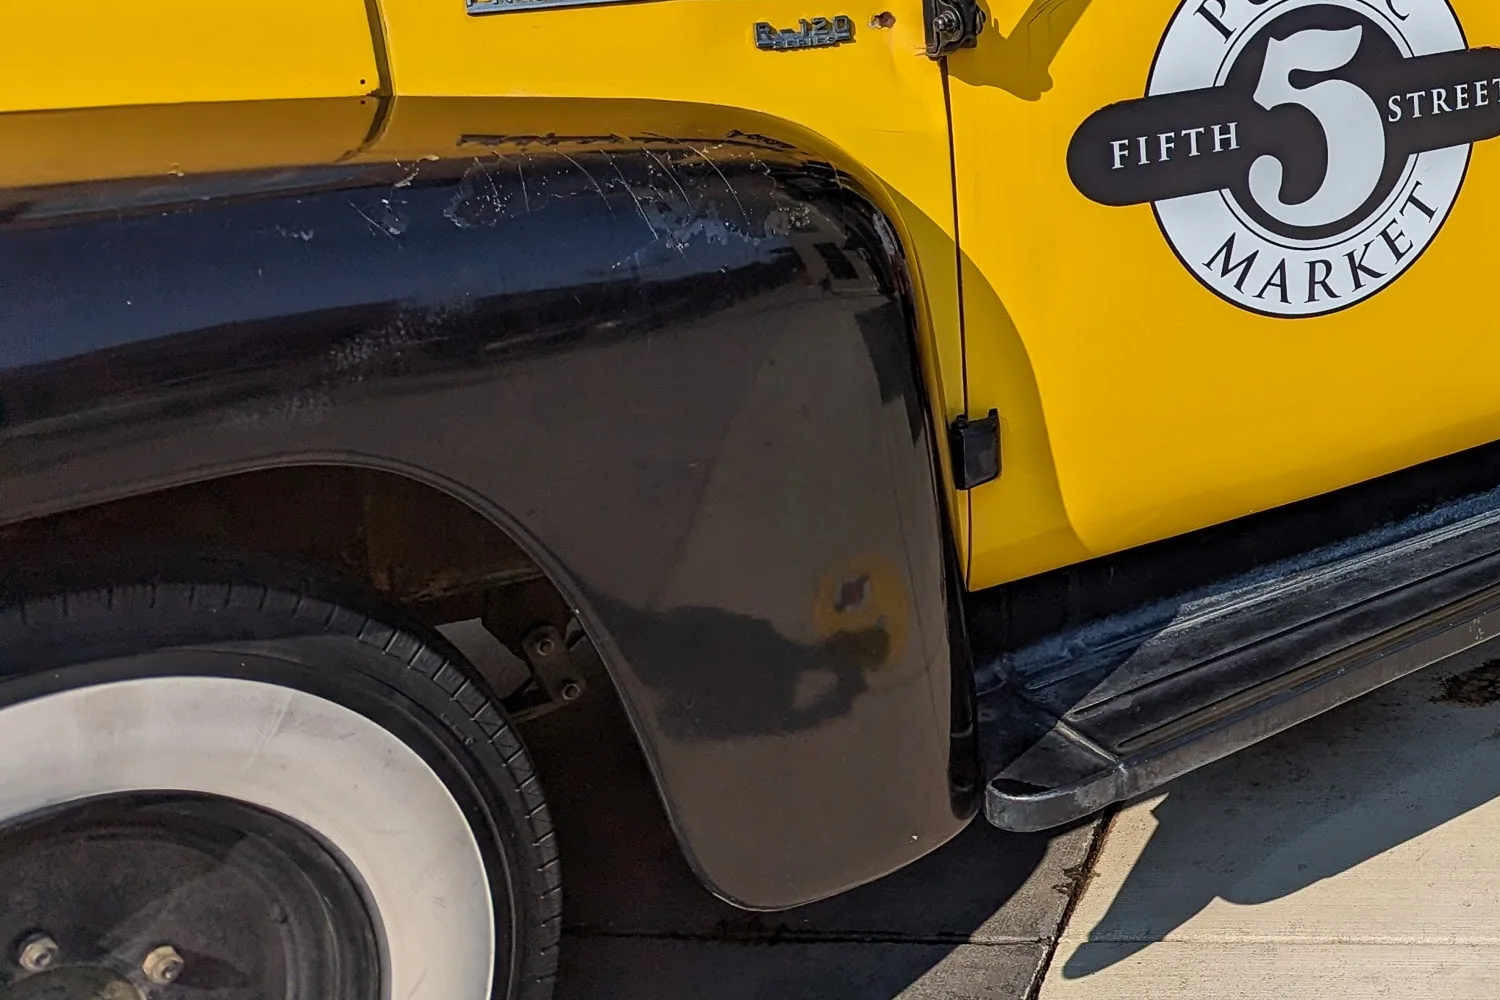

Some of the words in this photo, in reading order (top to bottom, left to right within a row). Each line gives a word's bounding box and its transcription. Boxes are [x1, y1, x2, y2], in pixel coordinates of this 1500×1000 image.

[754, 14, 852, 43] R-120
[1110, 121, 1241, 170] FIFTH
[1248, 24, 1386, 227] 5
[1202, 180, 1438, 305] MARKET
